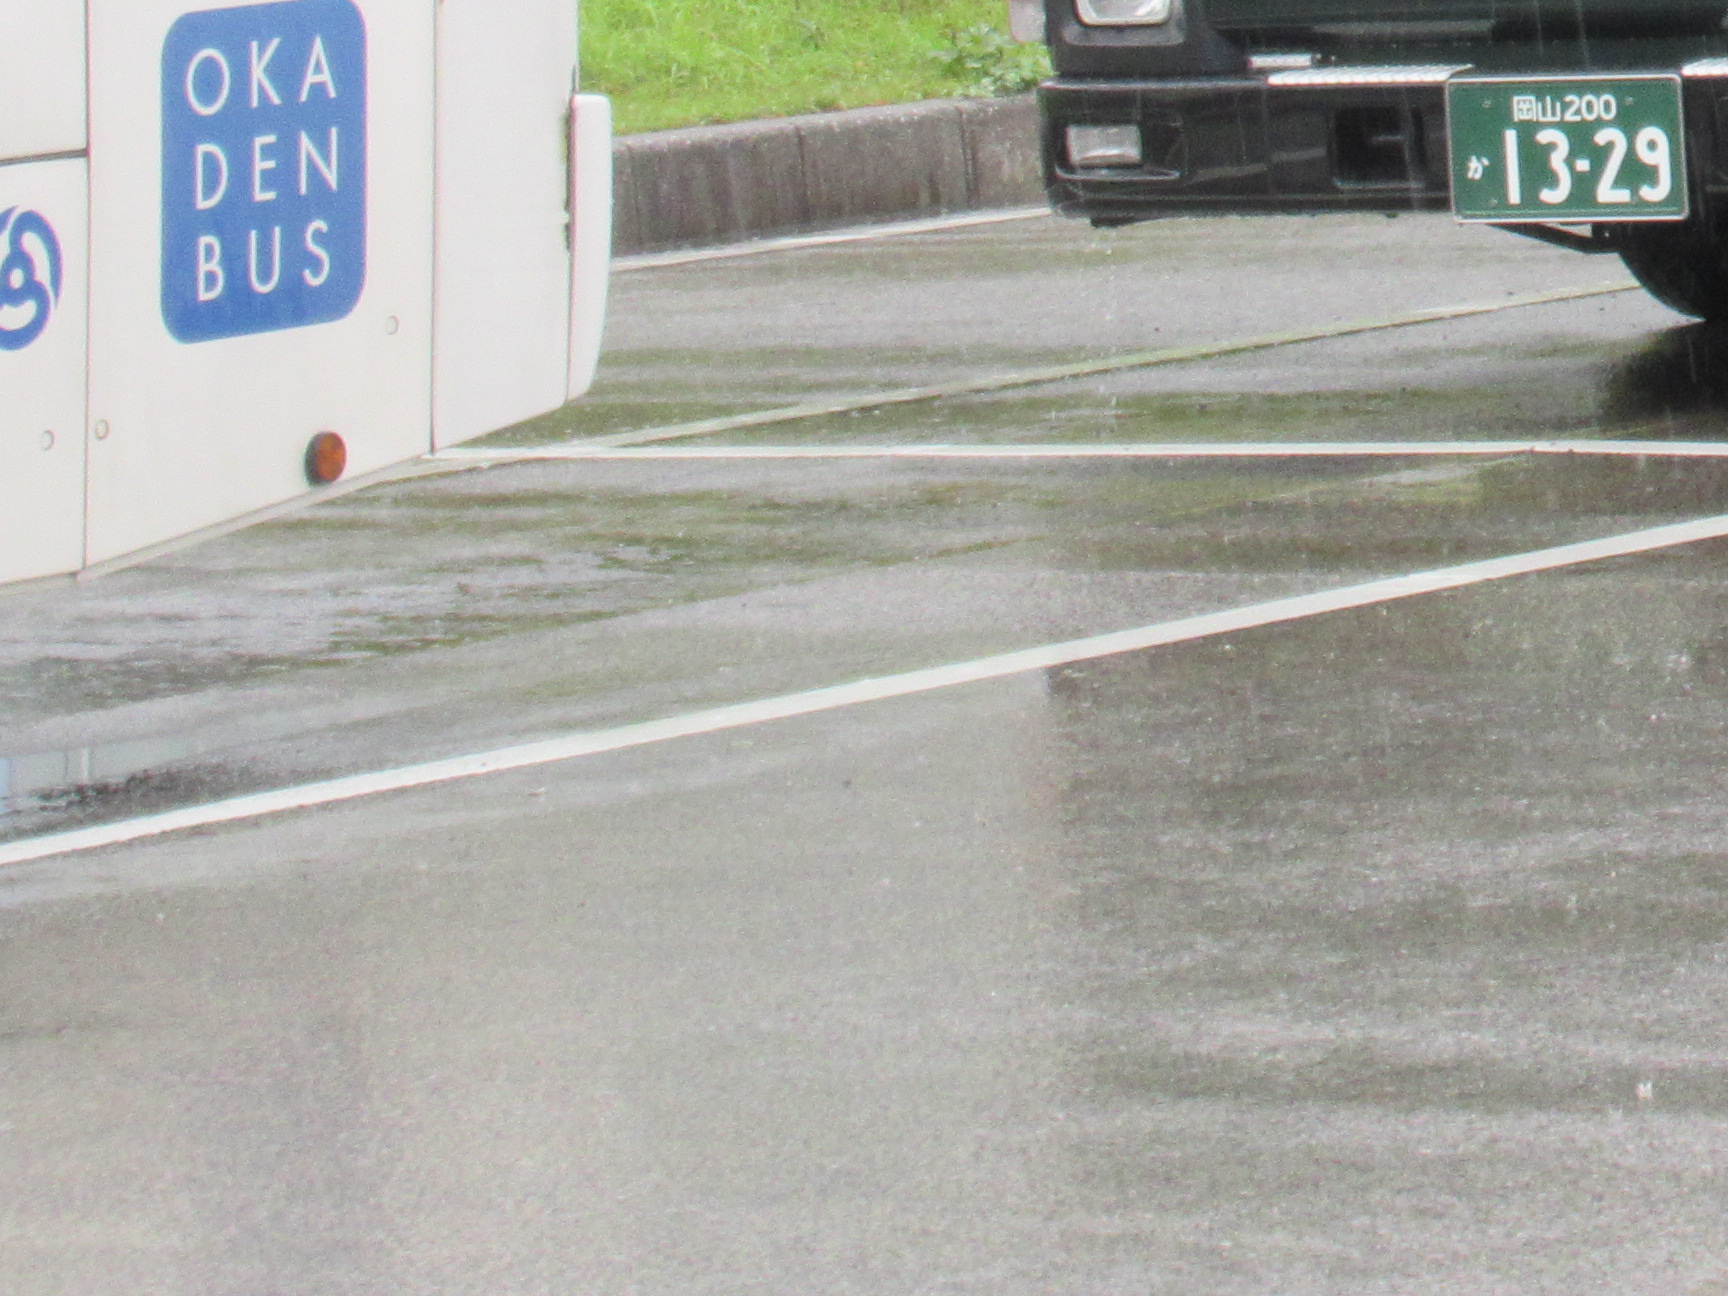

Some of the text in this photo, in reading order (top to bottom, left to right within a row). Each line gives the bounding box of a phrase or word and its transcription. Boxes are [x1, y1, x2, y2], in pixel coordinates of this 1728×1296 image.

[185, 35, 337, 116] OKA
[1513, 94, 1617, 123] 岡山200
[195, 127, 338, 210] DEN
[1466, 126, 1671, 205] か 13-29
[198, 219, 331, 302] BUS
